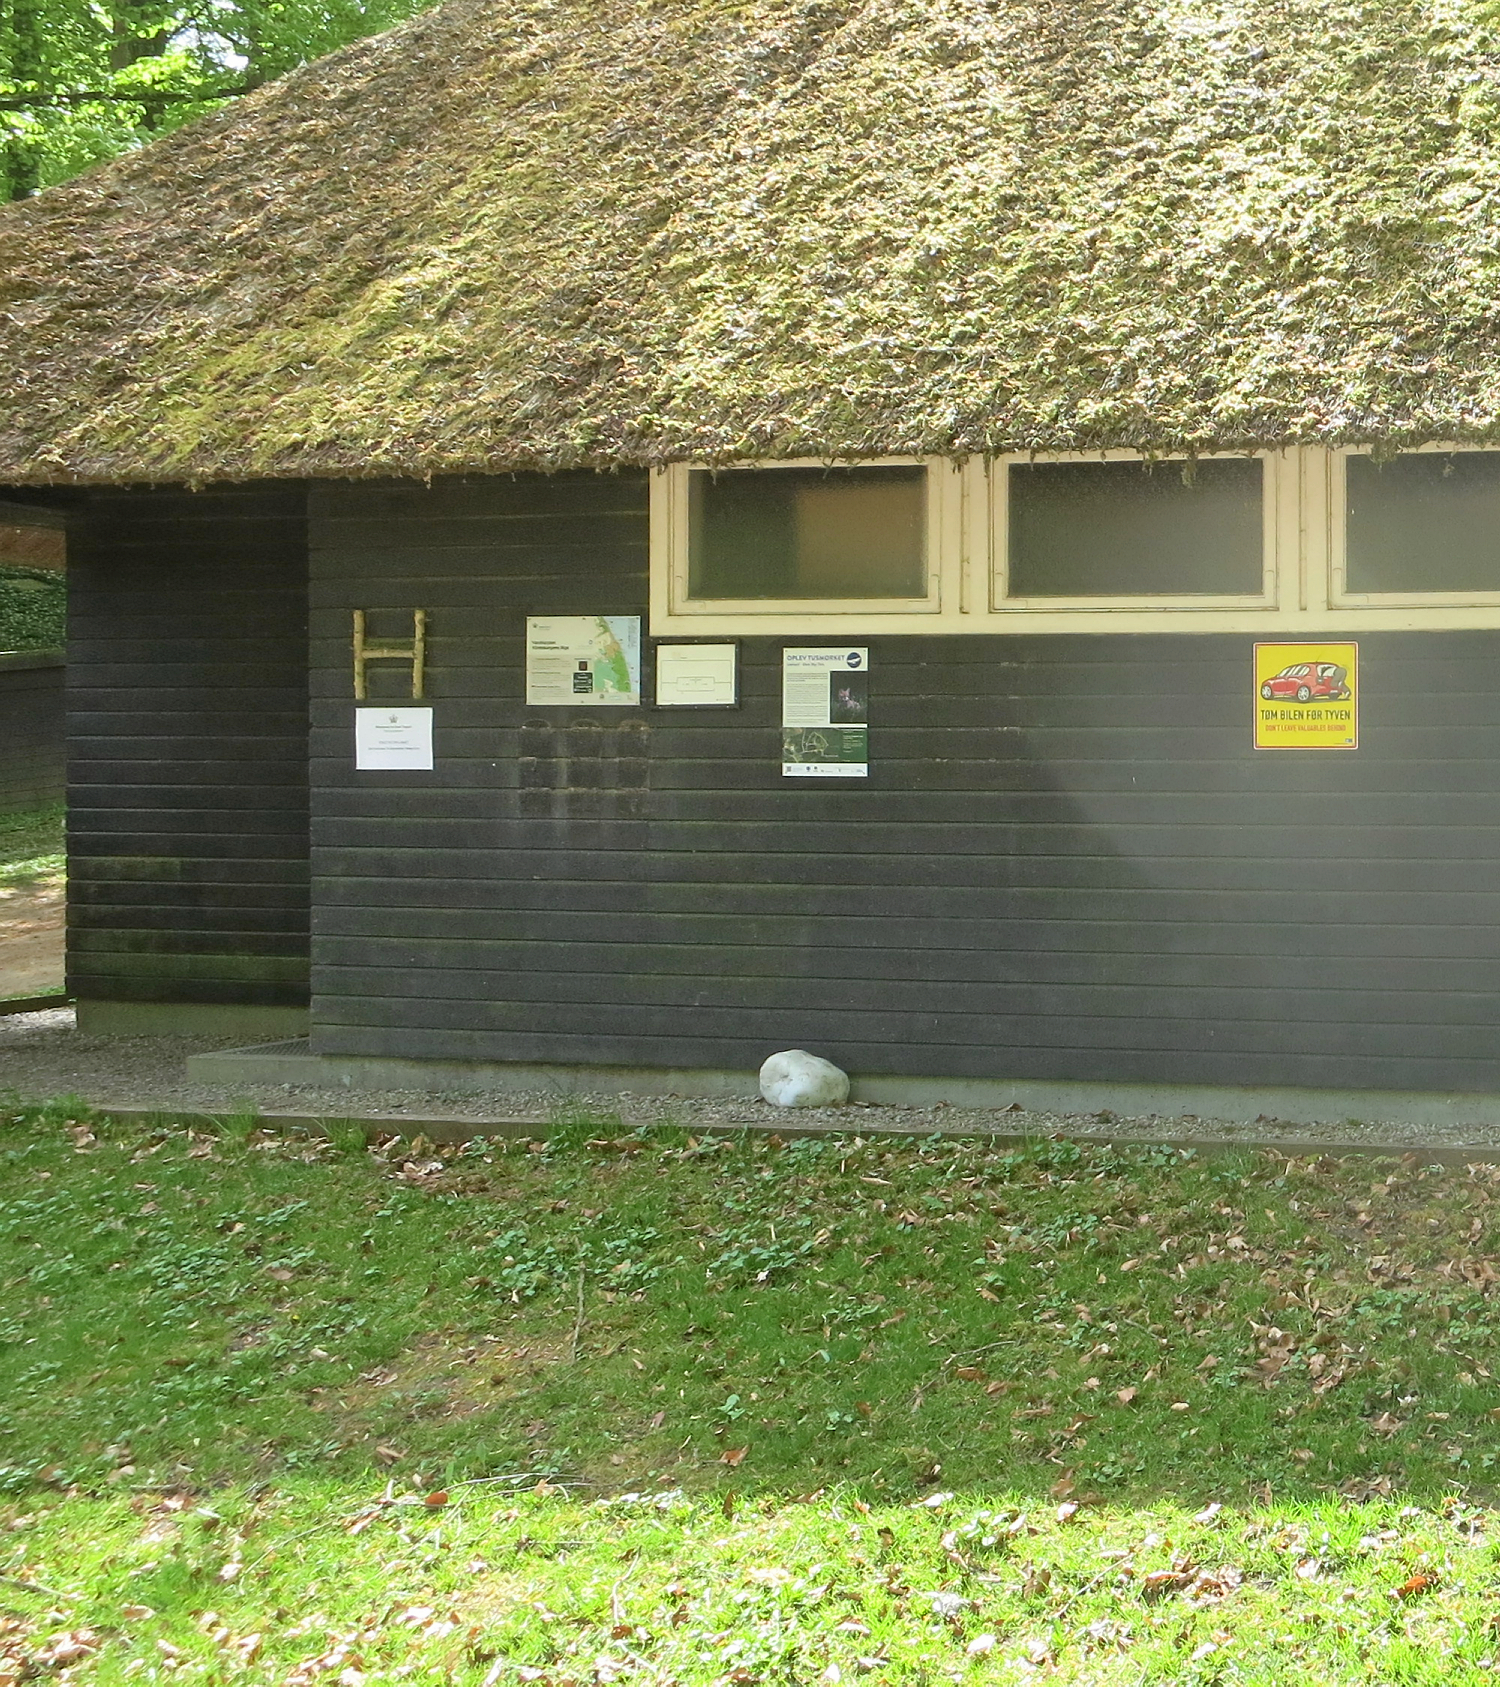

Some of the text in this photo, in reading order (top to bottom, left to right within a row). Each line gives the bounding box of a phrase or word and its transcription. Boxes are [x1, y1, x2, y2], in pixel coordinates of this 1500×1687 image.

[353, 609, 425, 700] H
[1261, 710, 1350, 720] TØM BILEN FØR TYVEN
